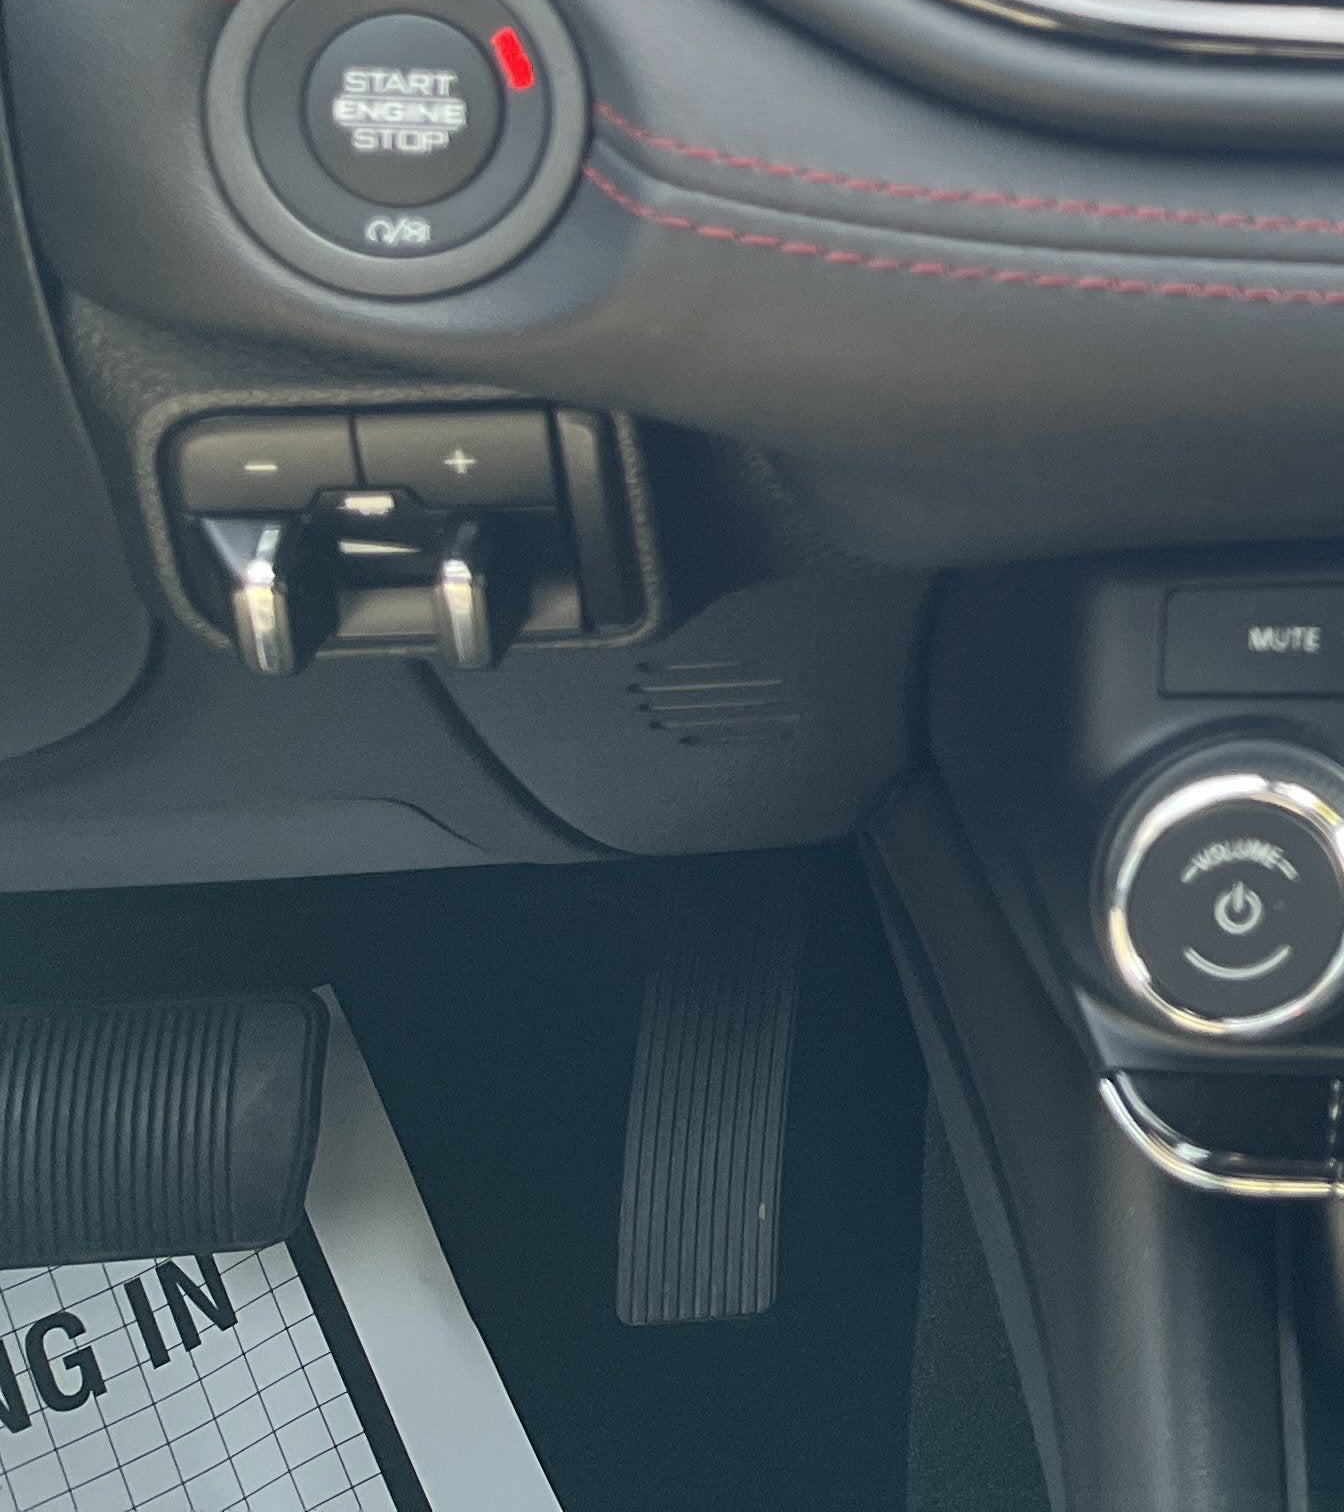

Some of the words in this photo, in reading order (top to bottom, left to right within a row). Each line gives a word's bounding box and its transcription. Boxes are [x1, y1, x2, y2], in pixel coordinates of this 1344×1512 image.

[343, 67, 458, 97] START
[331, 96, 468, 129] ENGINE
[350, 127, 450, 154] STOP
[1248, 625, 1321, 654] MUTE
[1194, 838, 1284, 871] VOLUME
[124, 1253, 239, 1370] IN
